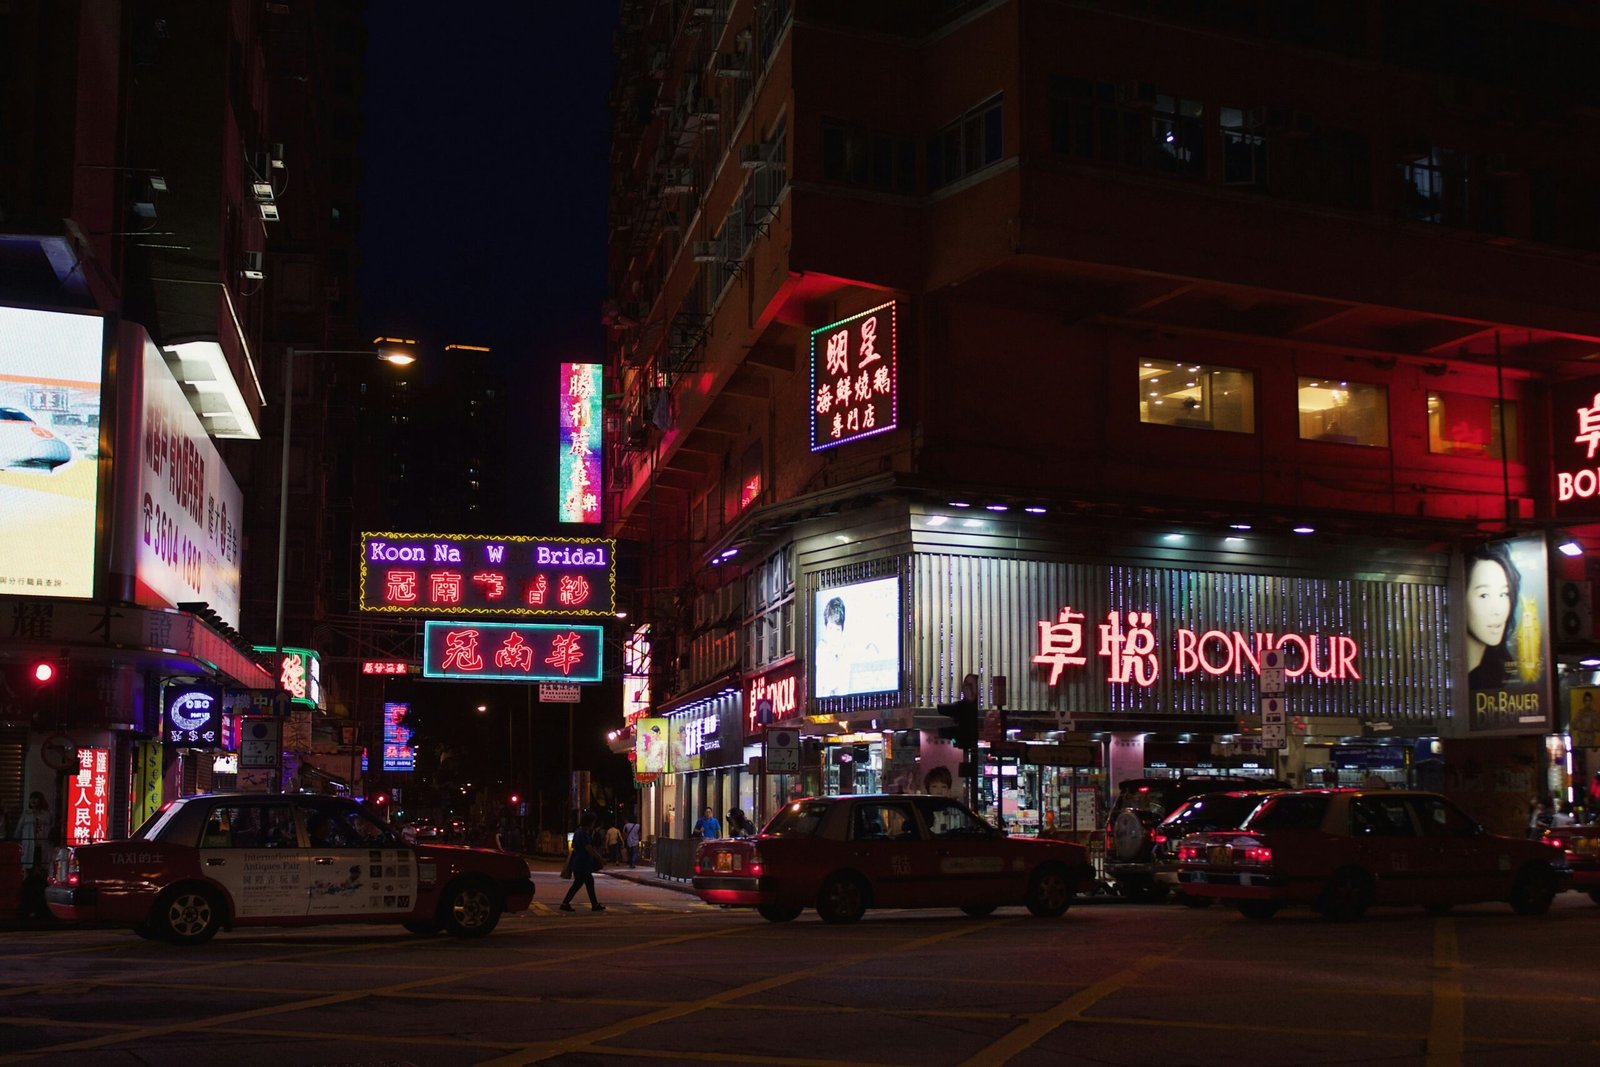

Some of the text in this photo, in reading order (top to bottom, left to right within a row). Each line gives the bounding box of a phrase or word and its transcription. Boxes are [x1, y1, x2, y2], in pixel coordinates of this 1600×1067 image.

[827, 316, 882, 375] 明星
[830, 403, 876, 439] 專門店
[1557, 467, 1600, 502] BO
[154, 503, 202, 595] 3604 1888
[371, 542, 426, 562] Koon
[537, 546, 607, 567] Bridal
[440, 629, 585, 674] 冠南華
[1032, 605, 1160, 687] 卓悅
[264, 755, 275, 764] 12
[786, 762, 797, 770] 12
[242, 861, 301, 873] Antiques Fair
